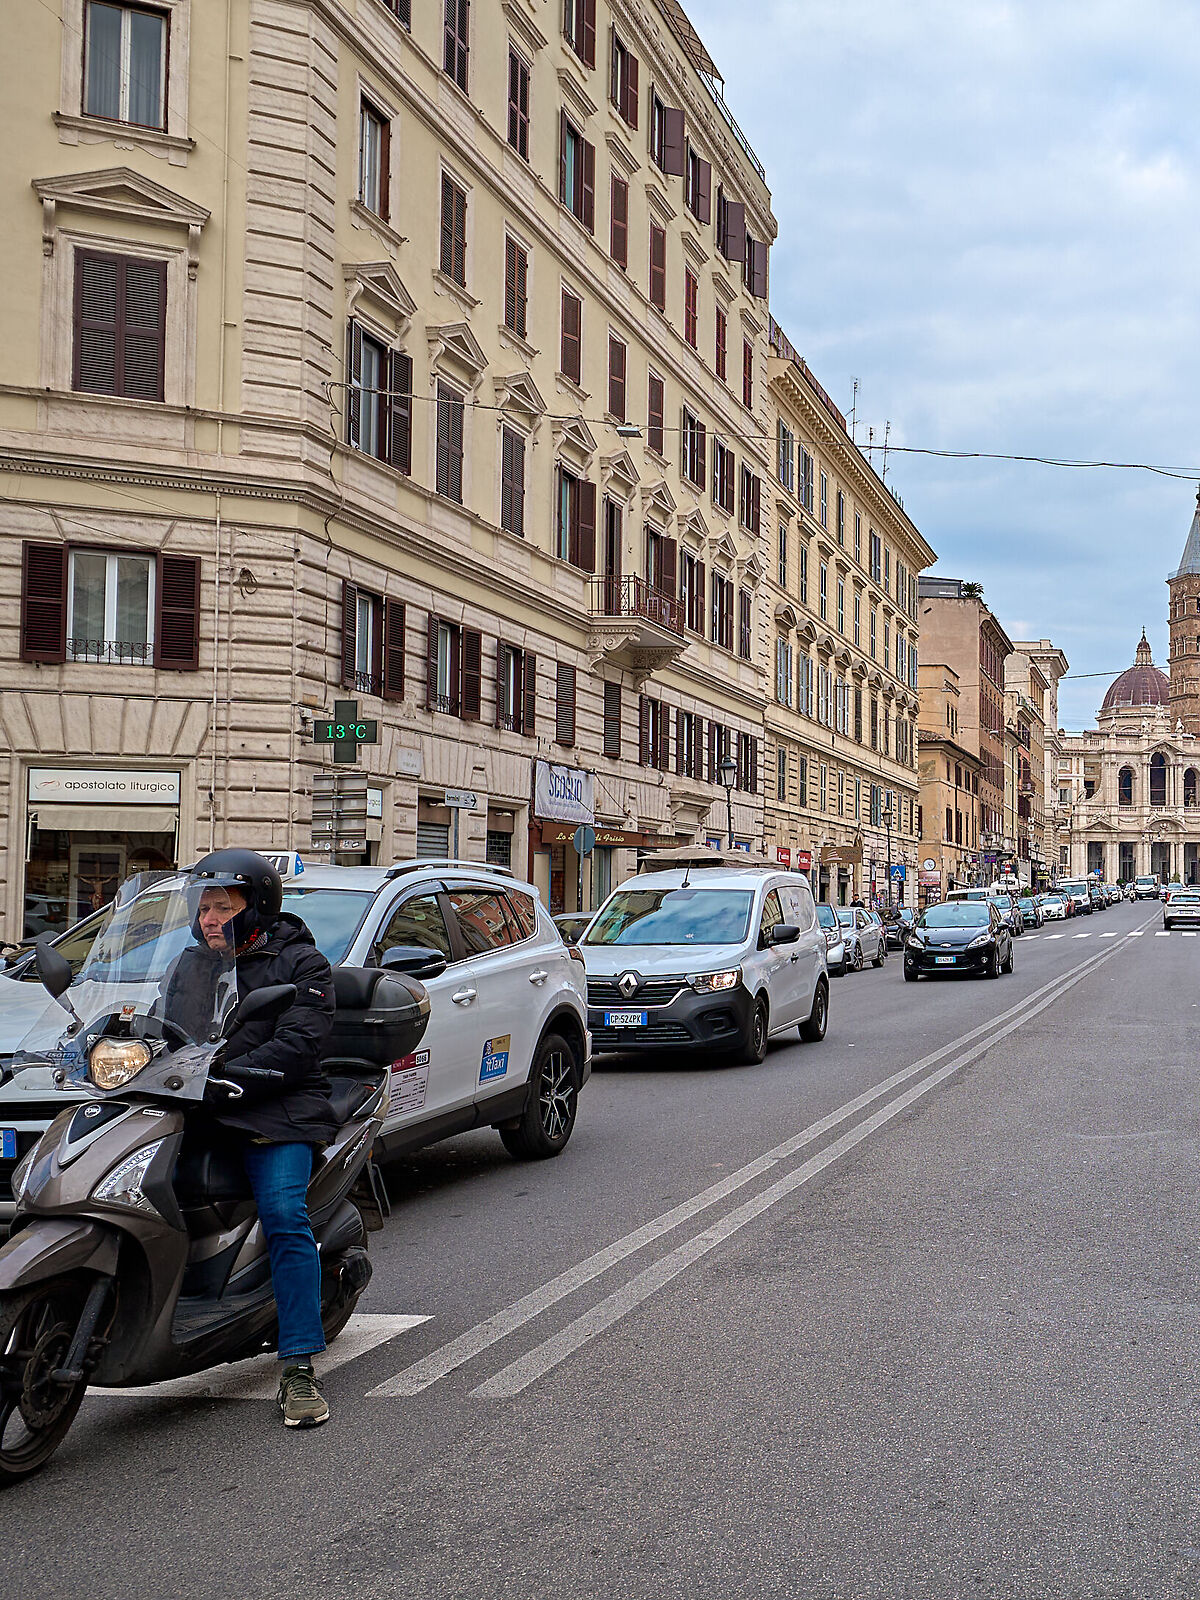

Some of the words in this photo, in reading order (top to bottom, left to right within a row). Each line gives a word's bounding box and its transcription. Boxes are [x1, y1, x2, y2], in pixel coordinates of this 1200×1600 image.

[326, 723, 367, 739] 13°C
[64, 780, 126, 790] apostolato
[130, 781, 176, 792] liturgico
[1027, 816, 1035, 857] HOTEL
